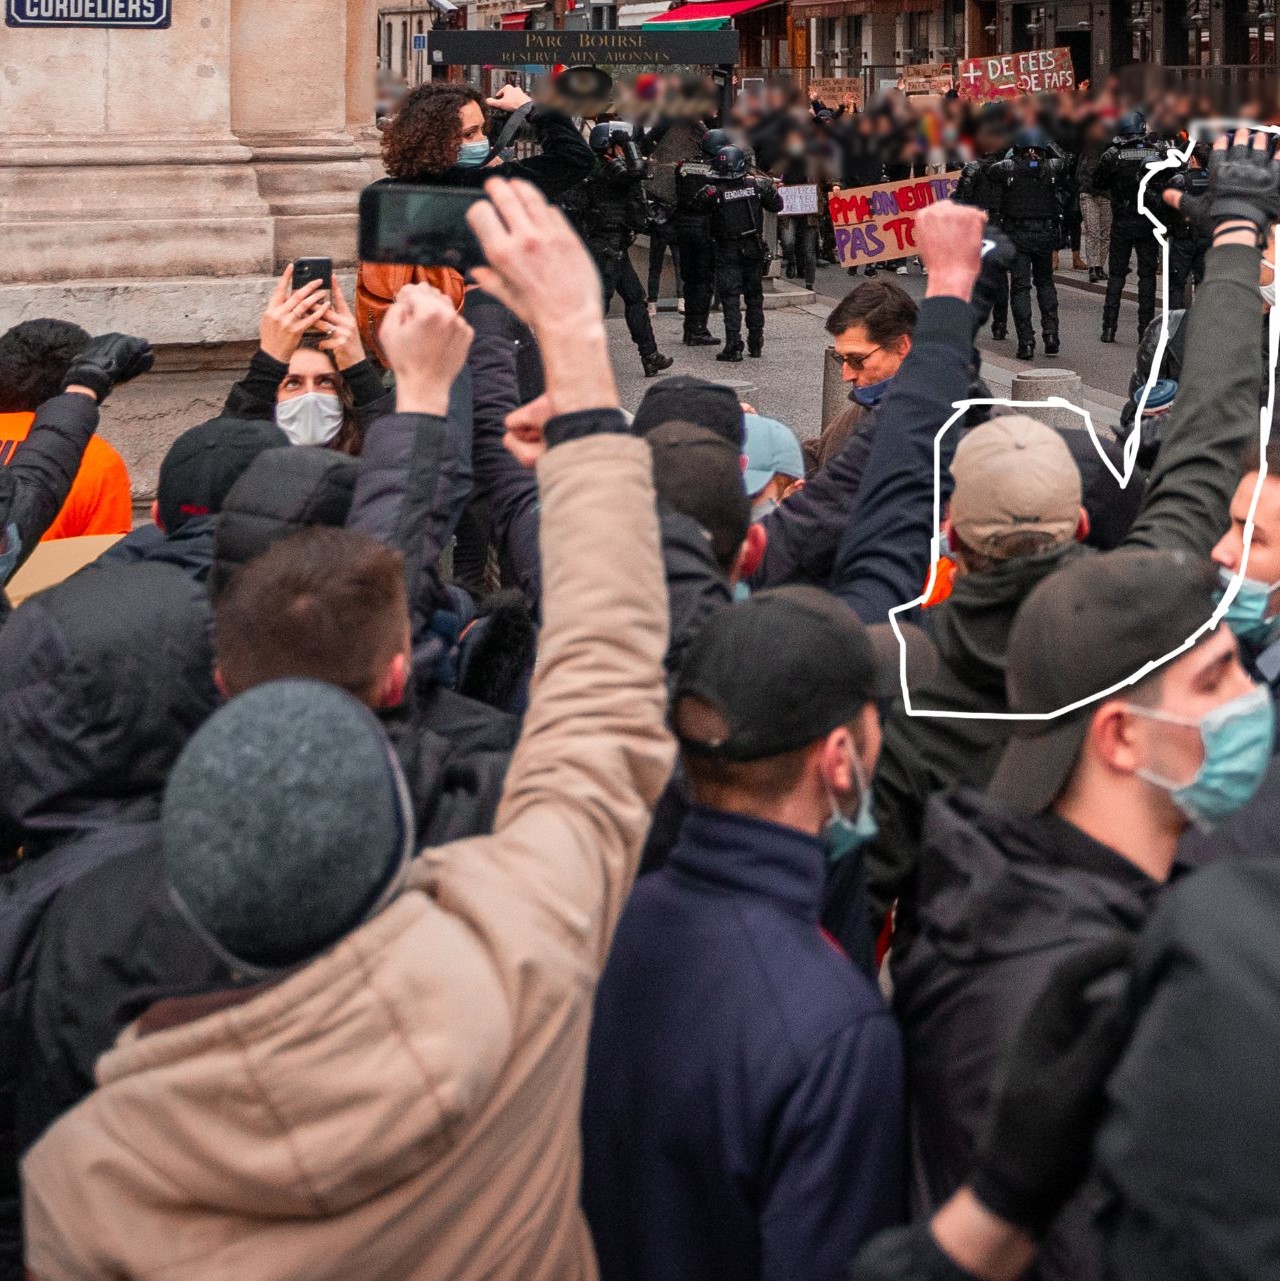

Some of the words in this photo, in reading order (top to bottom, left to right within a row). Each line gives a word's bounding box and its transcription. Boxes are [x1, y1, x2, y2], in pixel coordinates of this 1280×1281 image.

[569, 51, 596, 62] AUX
[987, 56, 1015, 80] DE
[1020, 73, 1042, 91] DE
[1044, 70, 1073, 88] FAFS
[724, 187, 756, 200] GENDARMERIE
[871, 190, 899, 216] ON
[894, 182, 935, 213] VEUT
[836, 223, 885, 262] PAS
